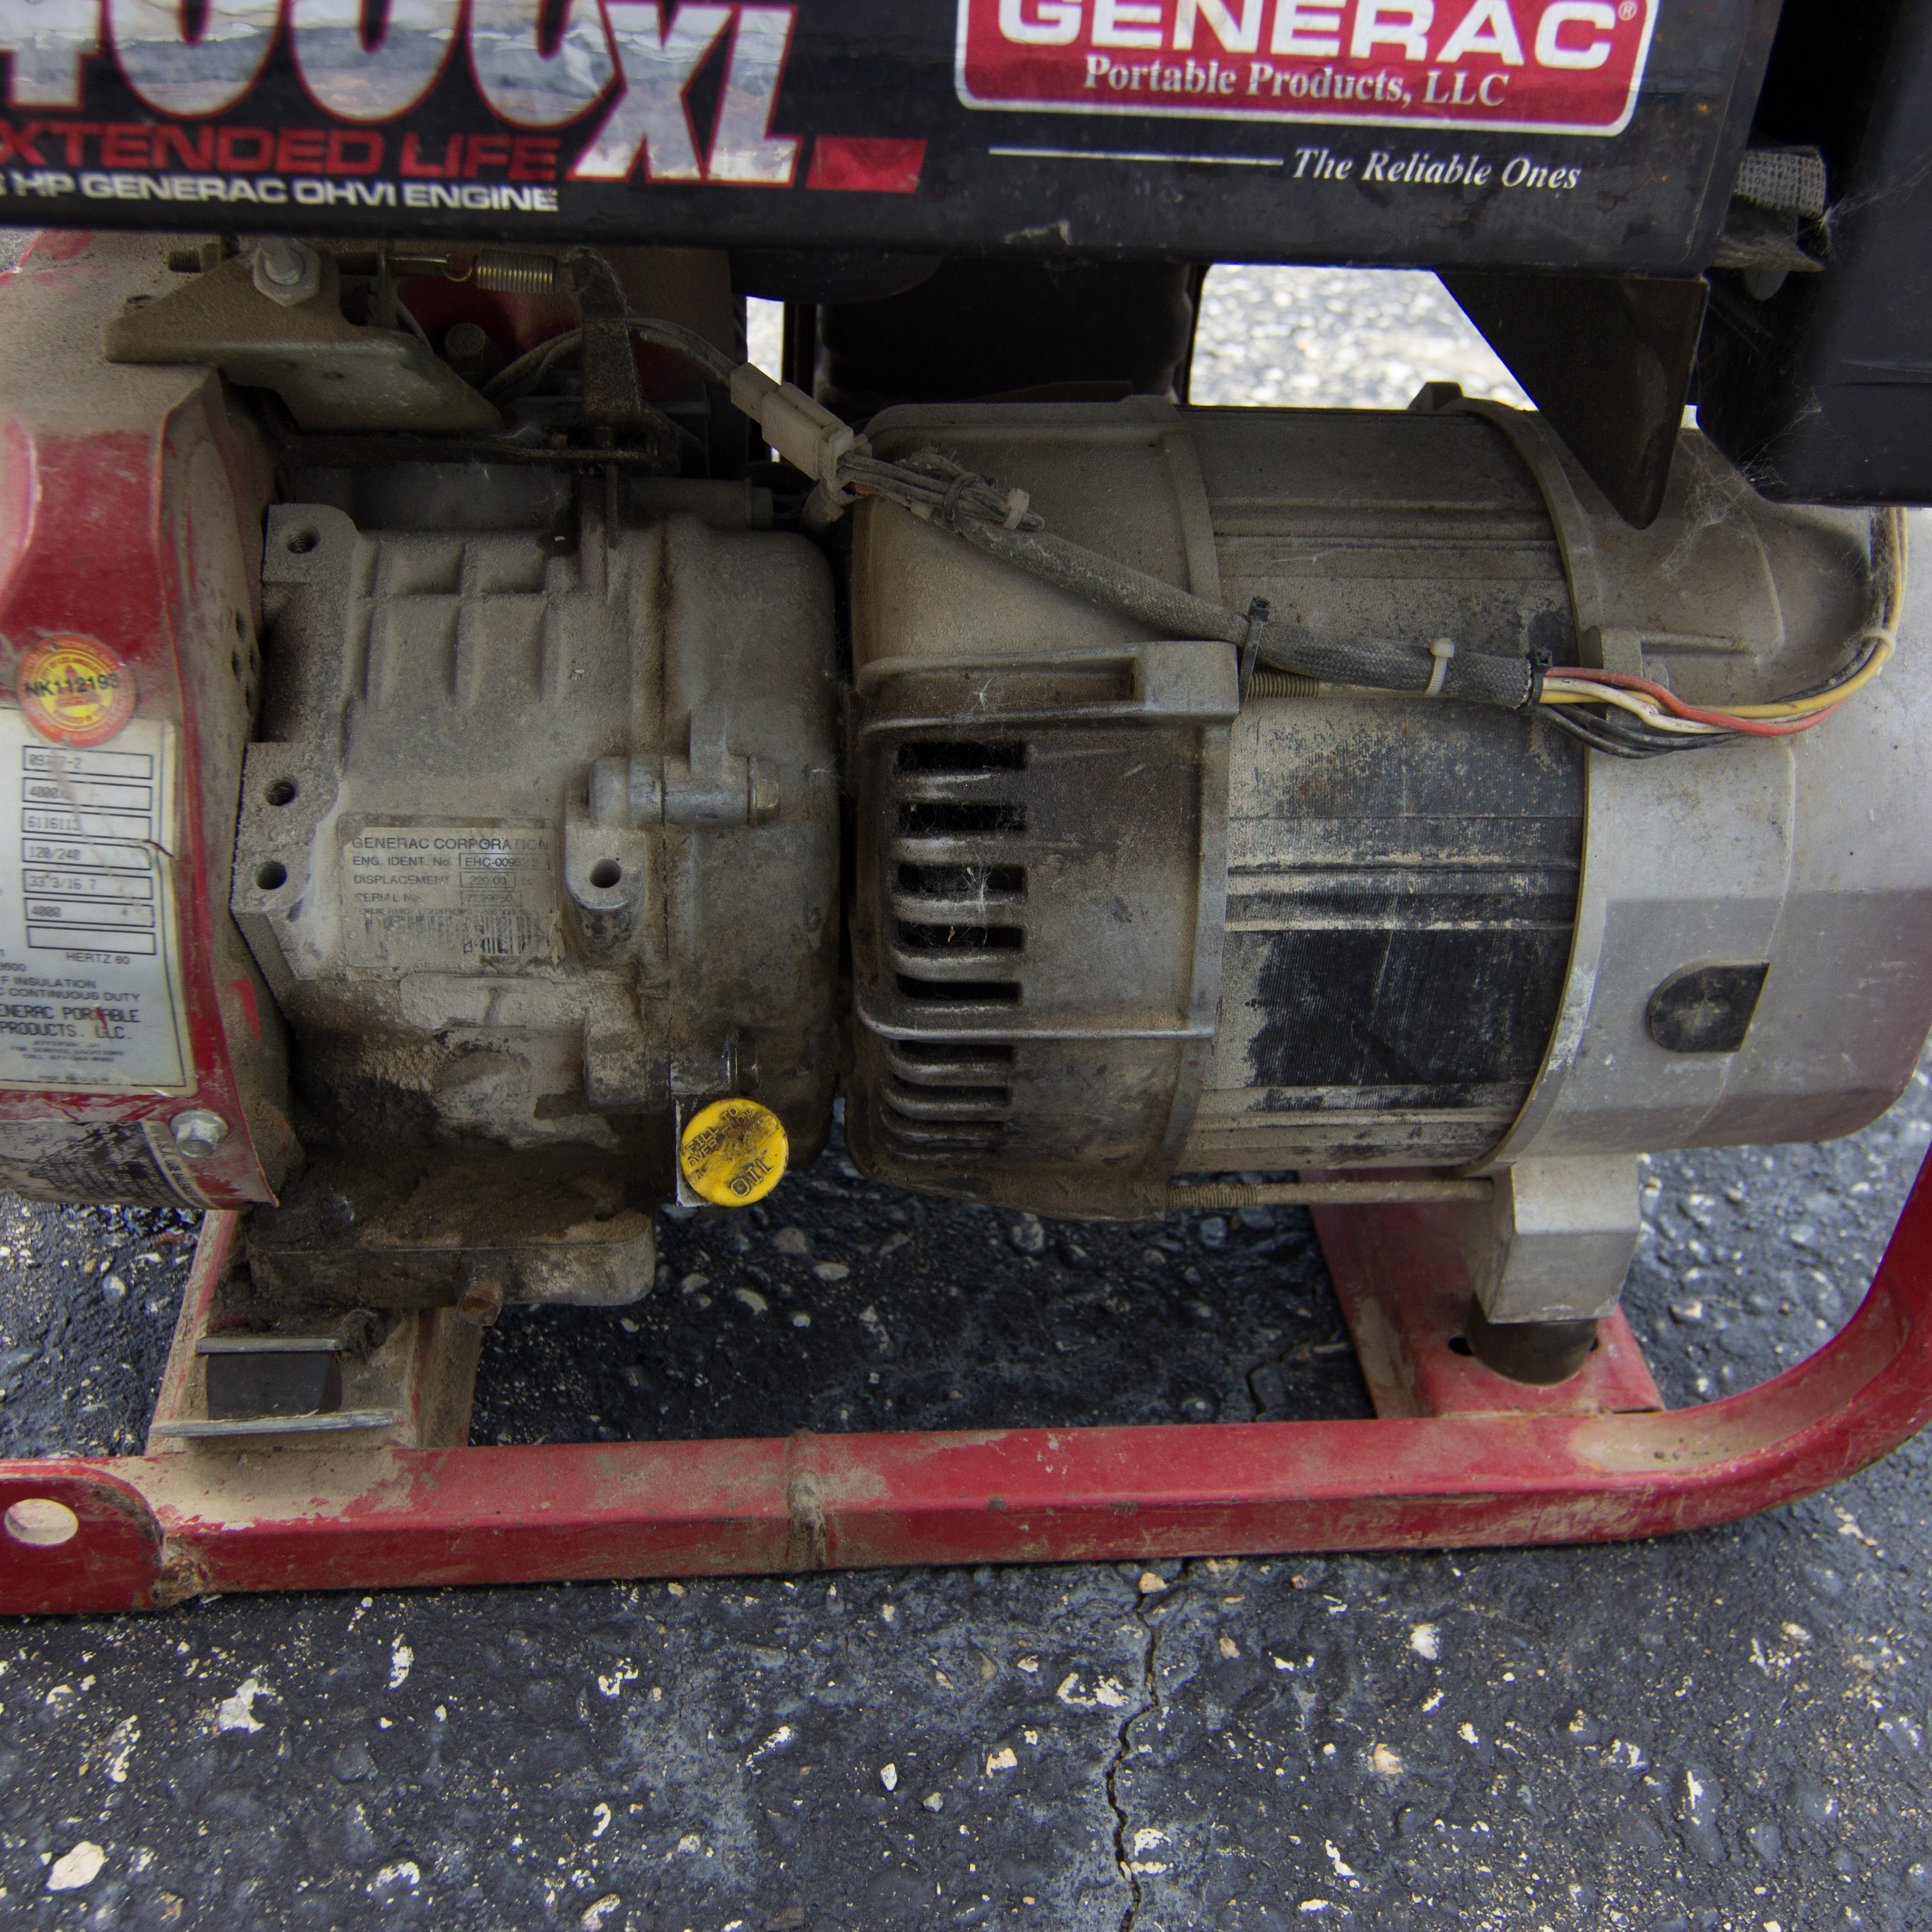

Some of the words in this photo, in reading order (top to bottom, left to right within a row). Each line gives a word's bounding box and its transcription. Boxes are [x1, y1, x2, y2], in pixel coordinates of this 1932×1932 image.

[997, 0, 1618, 69] GENERAC
[1082, 55, 1237, 94] Portable
[1248, 63, 1413, 108] Products,
[1422, 70, 1510, 106] LLC
[399, 132, 561, 182] LIFE
[1292, 148, 1353, 181] The
[1362, 151, 1491, 187] Reliable
[1502, 157, 1582, 191] Ones
[10, 169, 76, 197] HP
[78, 172, 288, 205] GENERAC
[292, 179, 398, 207] OHVI
[401, 183, 559, 212] ENGINE
[352, 837, 430, 849] GENERAC
[65, 952, 112, 964] HERTZ
[115, 956, 131, 964] 60
[8, 988, 100, 1001] CONTINUOUS
[103, 992, 141, 1002] DUTY
[13, 977, 97, 989] INSULATION
[685, 1125, 719, 1154] FILL
[720, 1106, 739, 1123] TO
[730, 1158, 779, 1197] OIL
